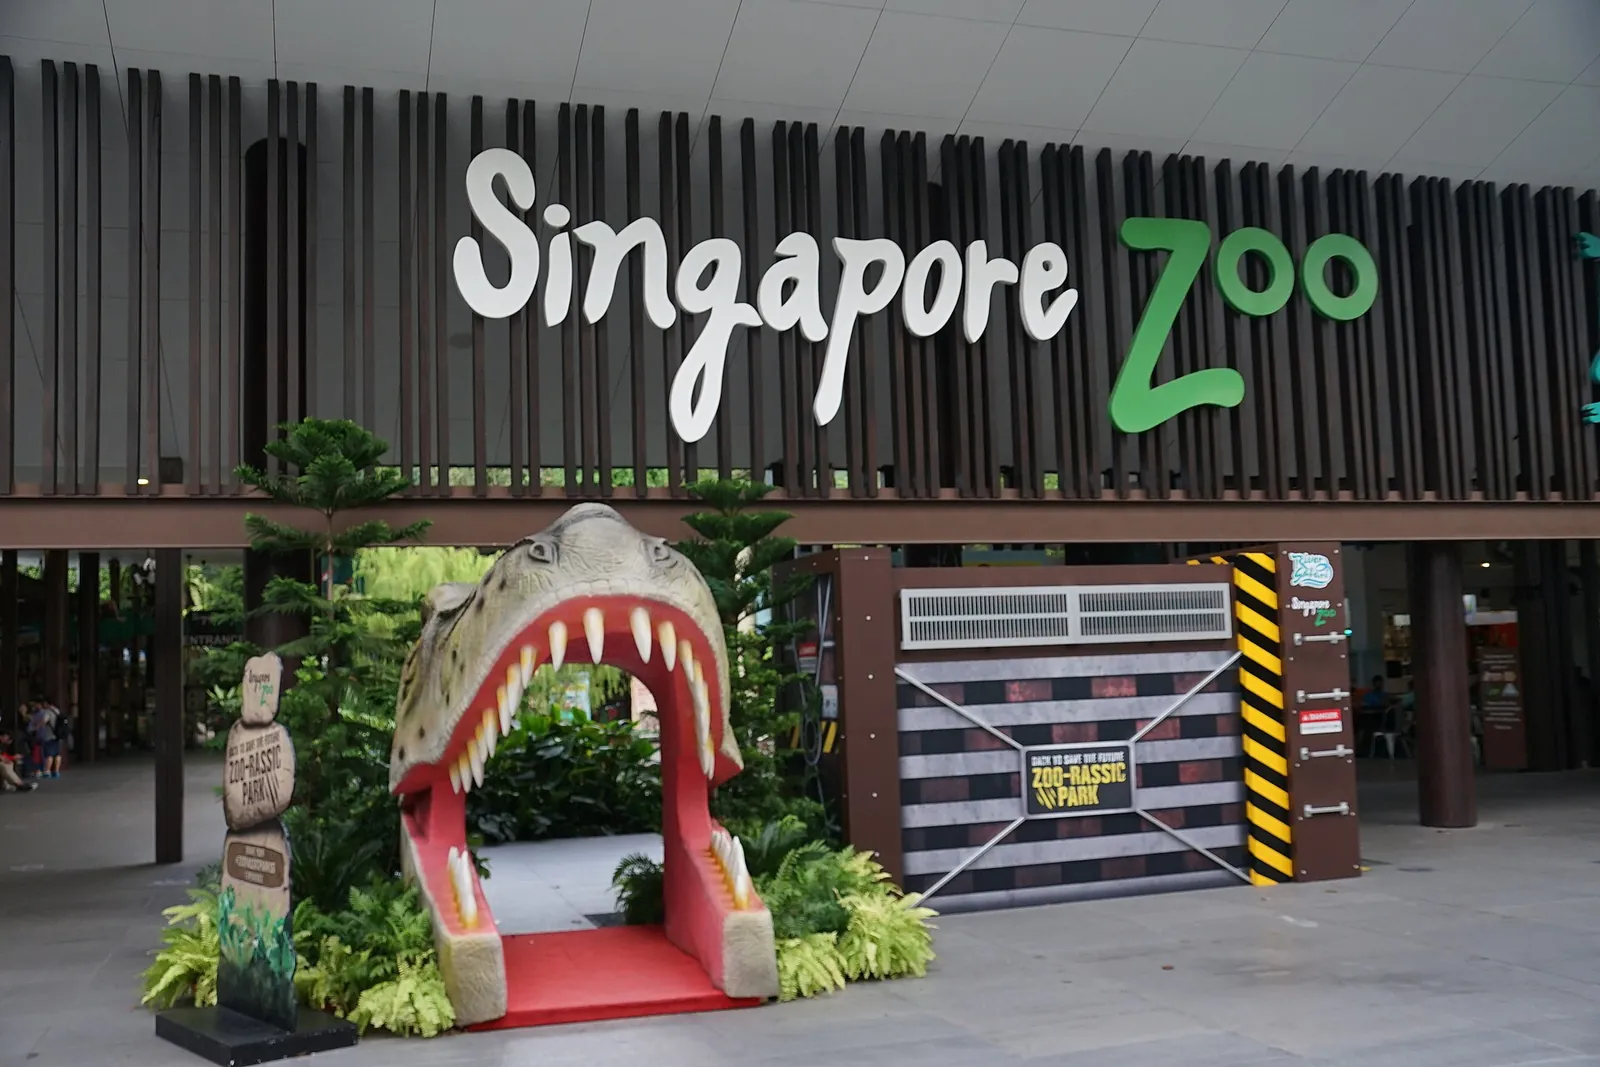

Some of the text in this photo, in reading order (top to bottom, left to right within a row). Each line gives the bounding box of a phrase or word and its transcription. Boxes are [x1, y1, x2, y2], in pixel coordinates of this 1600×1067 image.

[453, 147, 1380, 443] Singapore Zoo
[1291, 597, 1330, 617] Singapore
[1314, 609, 1337, 627] Zoo
[1308, 711, 1339, 721] DANGER
[230, 744, 281, 783] ZOO-RASSIC
[1031, 751, 1125, 766] BACK TO SAVE THE FUTURE
[1032, 762, 1127, 788] ZOO-RASSIC
[242, 777, 265, 806] PARK
[1057, 785, 1100, 807] PARK
